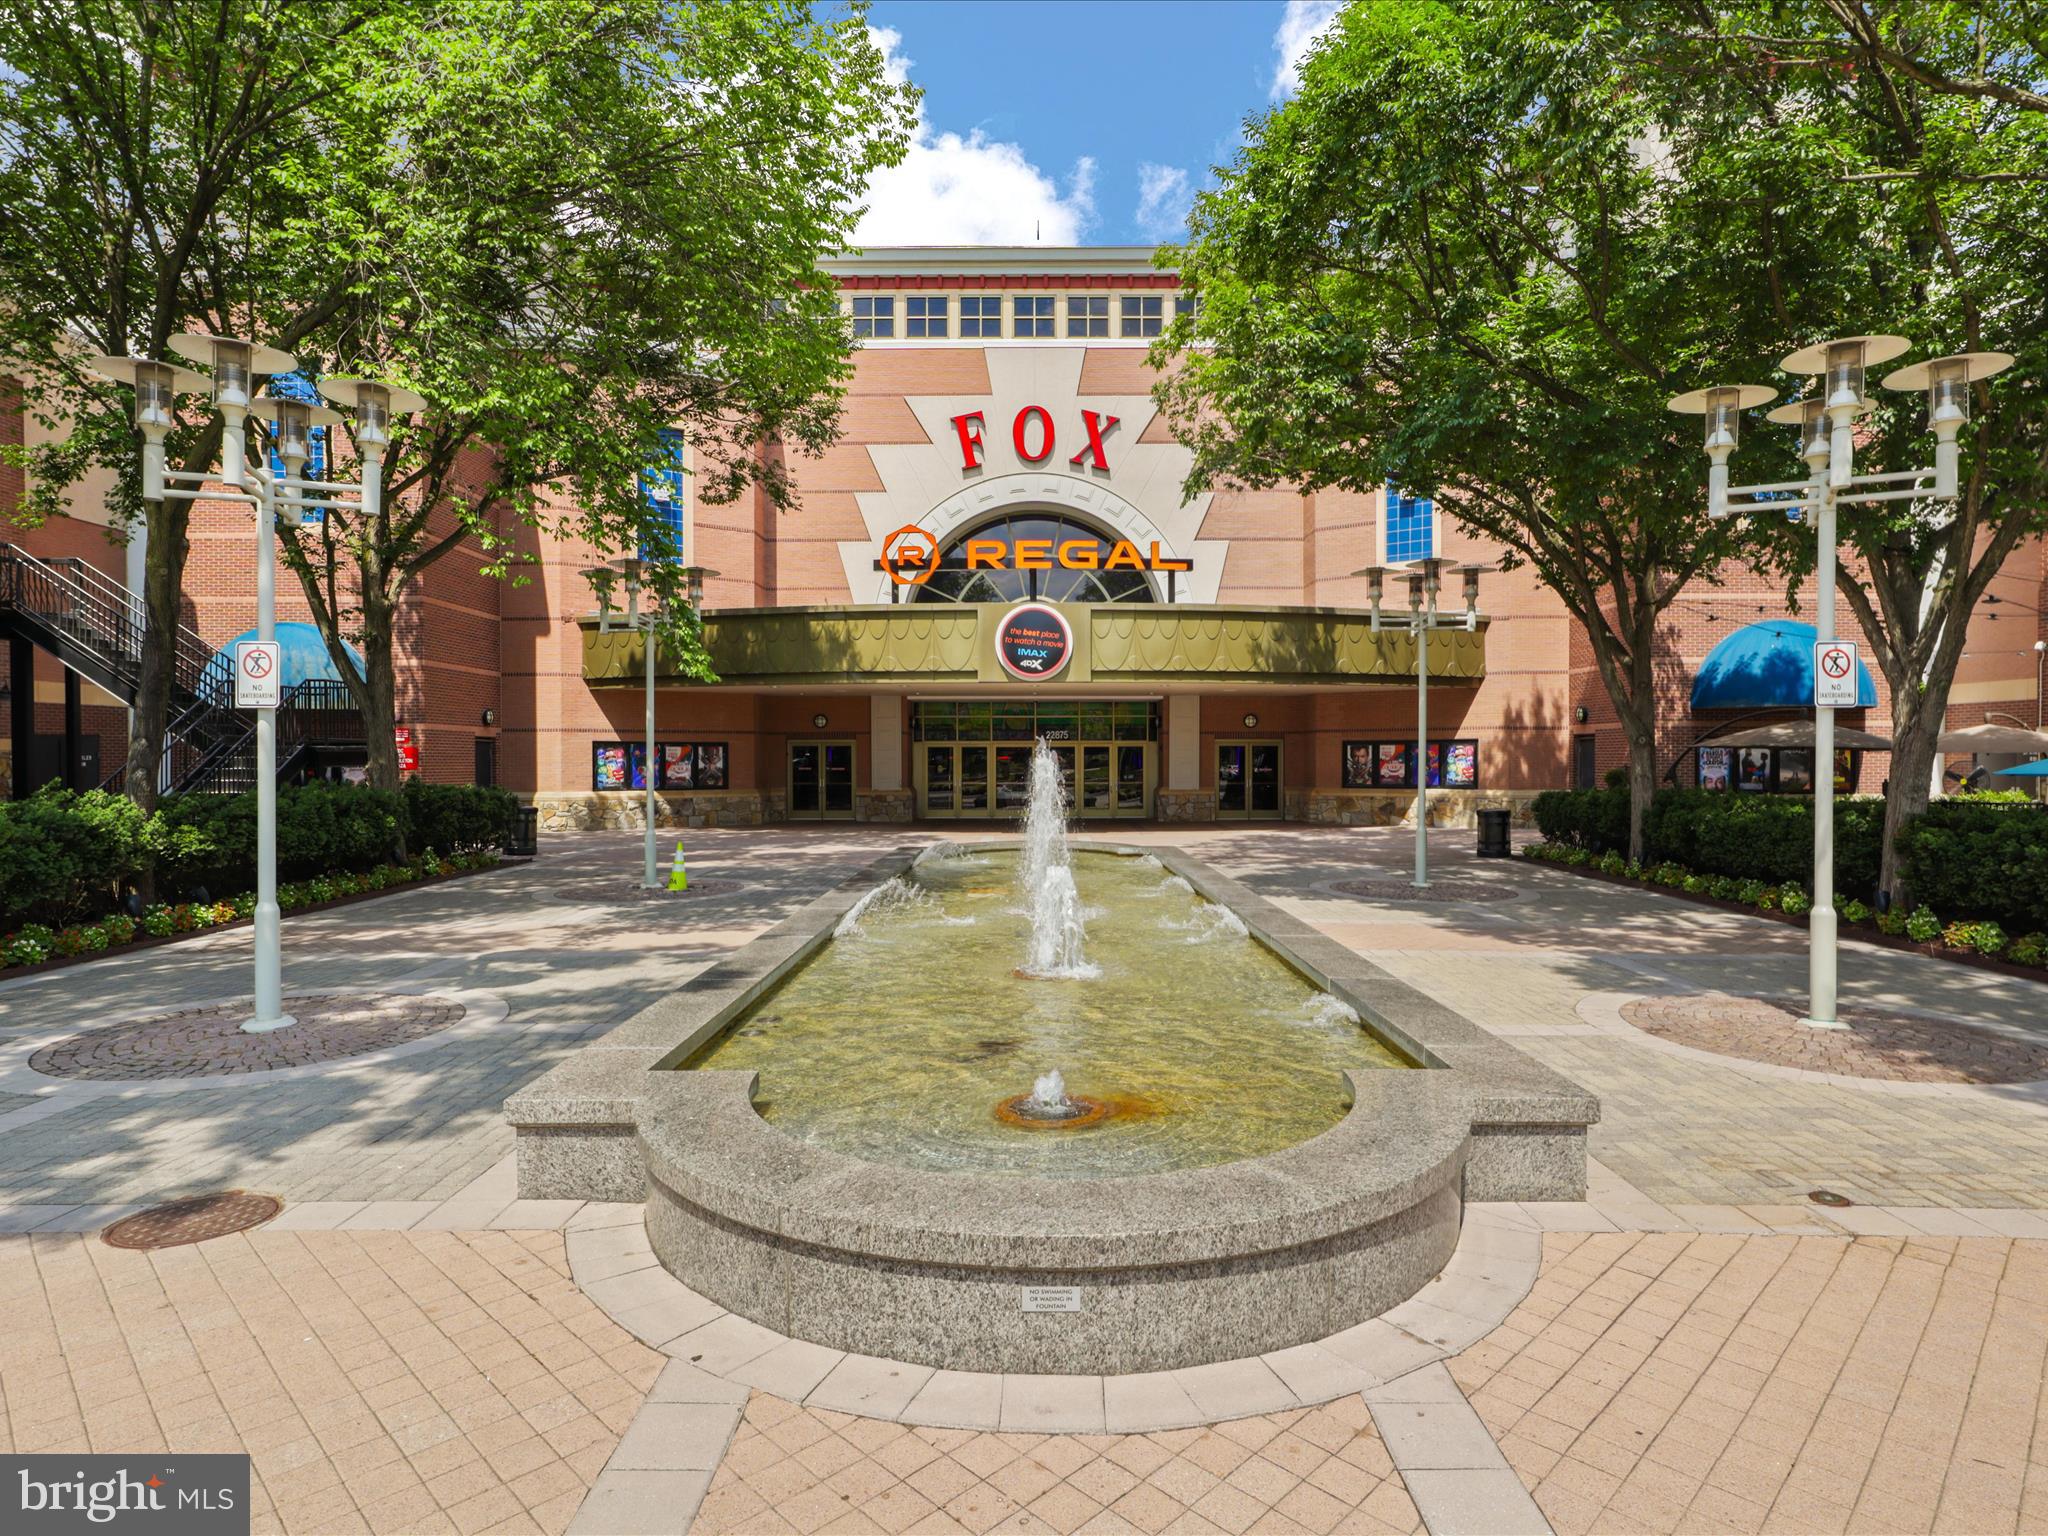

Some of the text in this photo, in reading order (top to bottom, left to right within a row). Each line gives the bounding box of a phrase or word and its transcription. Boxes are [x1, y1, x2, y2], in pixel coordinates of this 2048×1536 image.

[950, 405, 1120, 471] FOX
[967, 540, 1188, 571] REGAL
[1023, 628, 1040, 637] best
[1041, 630, 1060, 639] place
[1014, 637, 1036, 646] watch
[1043, 640, 1064, 648] movie
[1018, 648, 1047, 658] IMAX
[1020, 659, 1043, 671] 4DX
[1046, 730, 1069, 739] 22875
